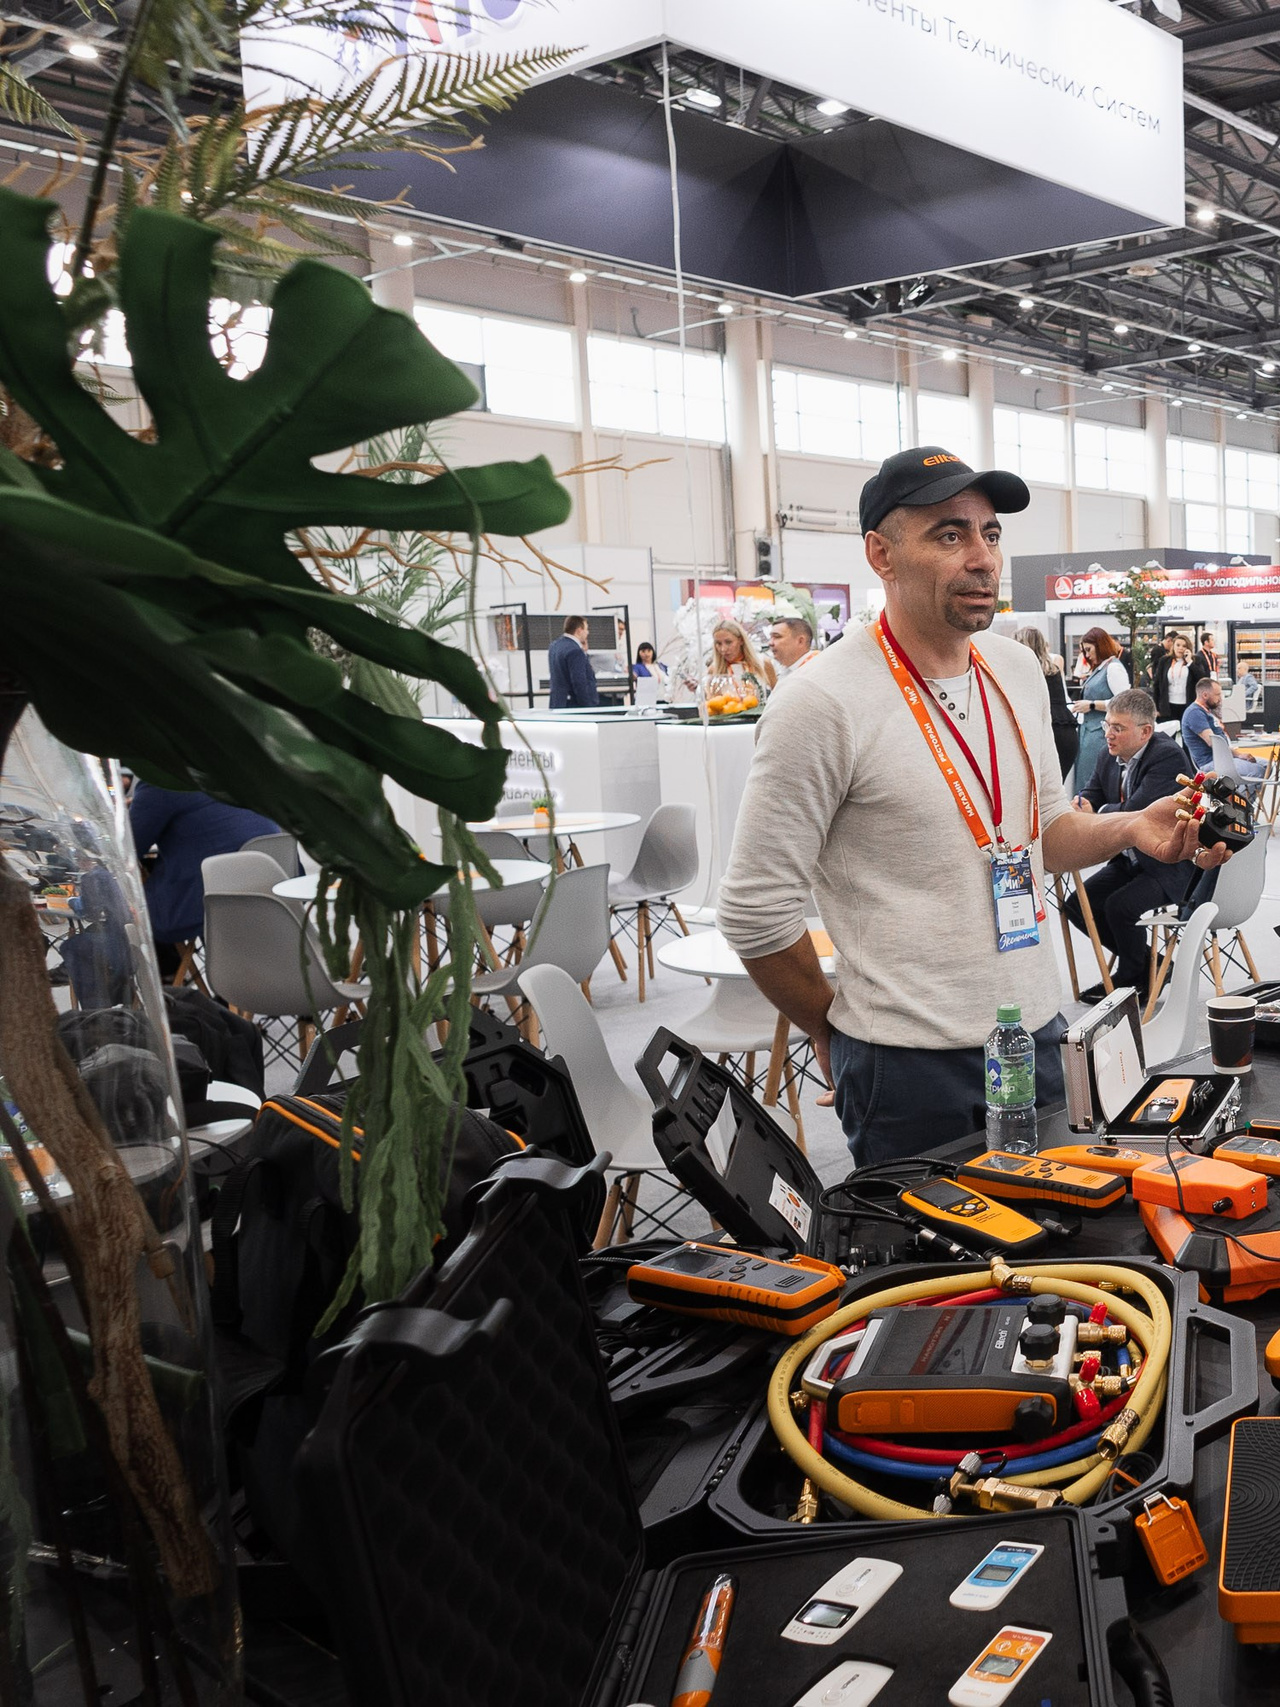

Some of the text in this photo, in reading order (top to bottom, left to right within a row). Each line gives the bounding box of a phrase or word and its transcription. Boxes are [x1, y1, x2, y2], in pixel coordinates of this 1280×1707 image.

[857, 0, 1161, 134] енты Технических Систем
[1141, 578, 1212, 592] роизводство
[1242, 600, 1279, 611] шкафы
[881, 635, 900, 670] МАГАЗИН
[923, 722, 975, 818] МАГАЗИН И РЕСТОРАН
